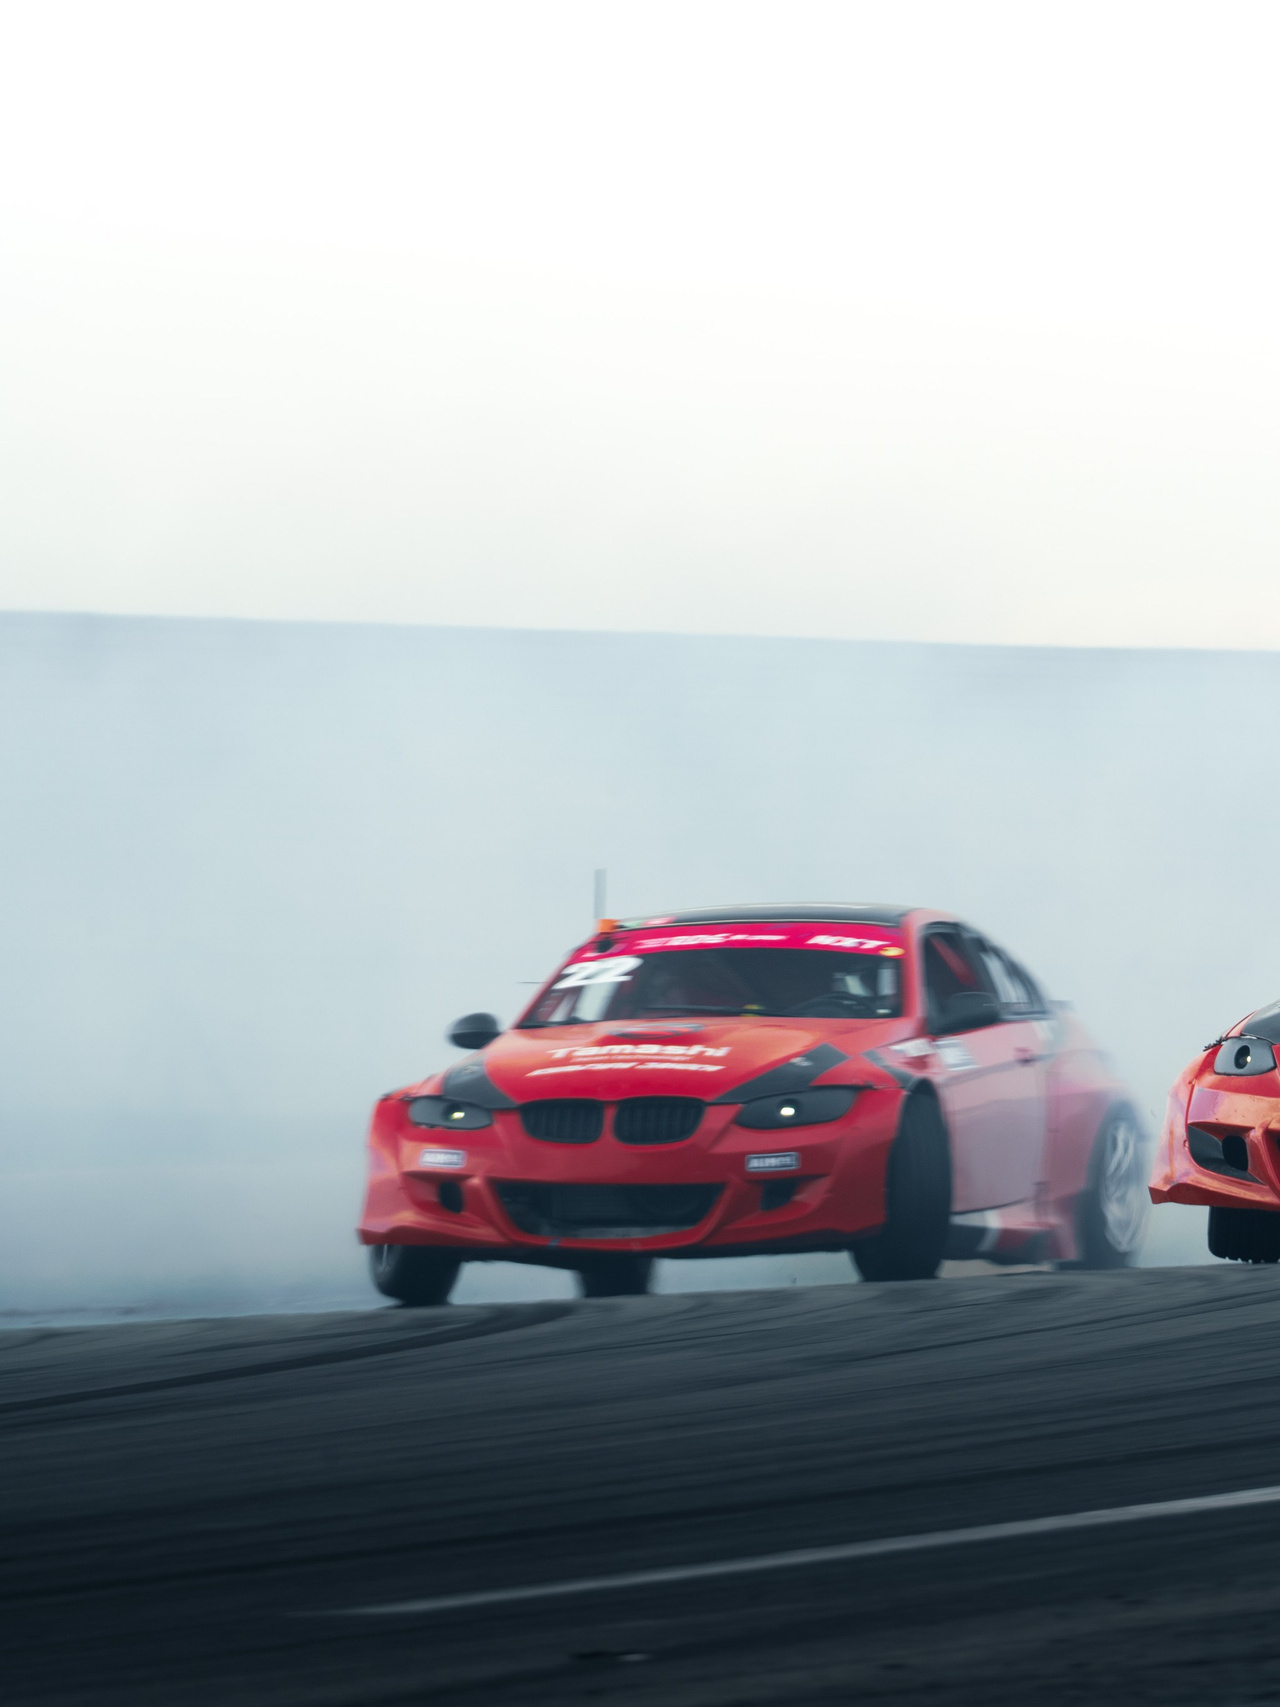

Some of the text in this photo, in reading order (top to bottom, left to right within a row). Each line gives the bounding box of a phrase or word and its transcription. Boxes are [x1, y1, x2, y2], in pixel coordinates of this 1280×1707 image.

[806, 934, 891, 948] NXT
[552, 955, 644, 989] 22
[547, 1044, 732, 1058] Tamashi
